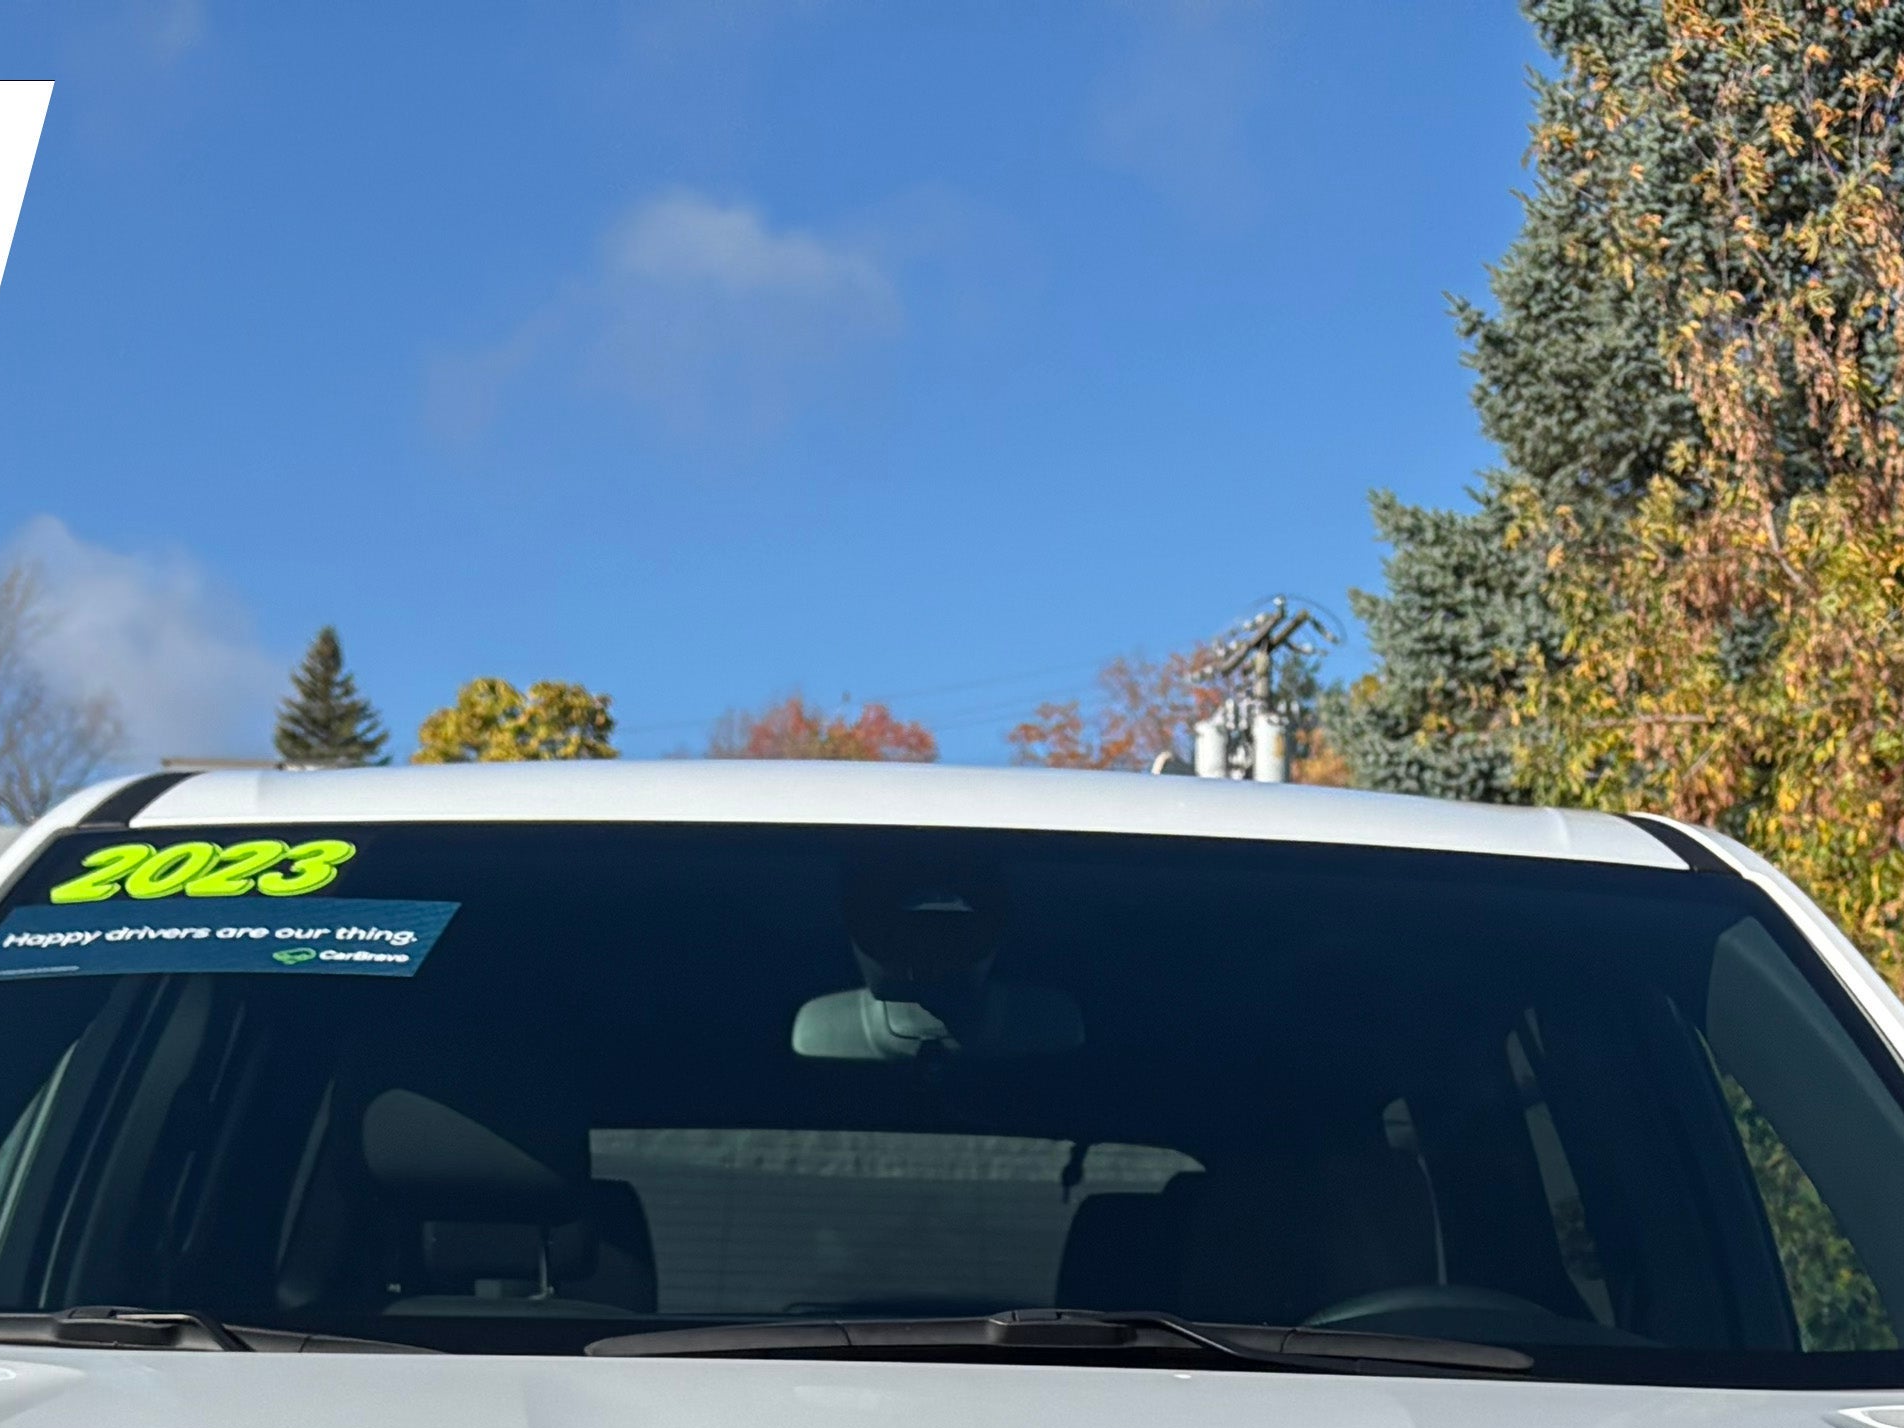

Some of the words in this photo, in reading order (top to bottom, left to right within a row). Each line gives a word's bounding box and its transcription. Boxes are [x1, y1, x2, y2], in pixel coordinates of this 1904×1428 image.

[49, 839, 356, 904] 2023
[2, 930, 102, 948] Happy
[104, 926, 212, 942] drivers
[216, 927, 270, 939] are
[274, 927, 331, 940] our
[335, 926, 418, 946] thing.
[318, 949, 410, 963] CarBravo
